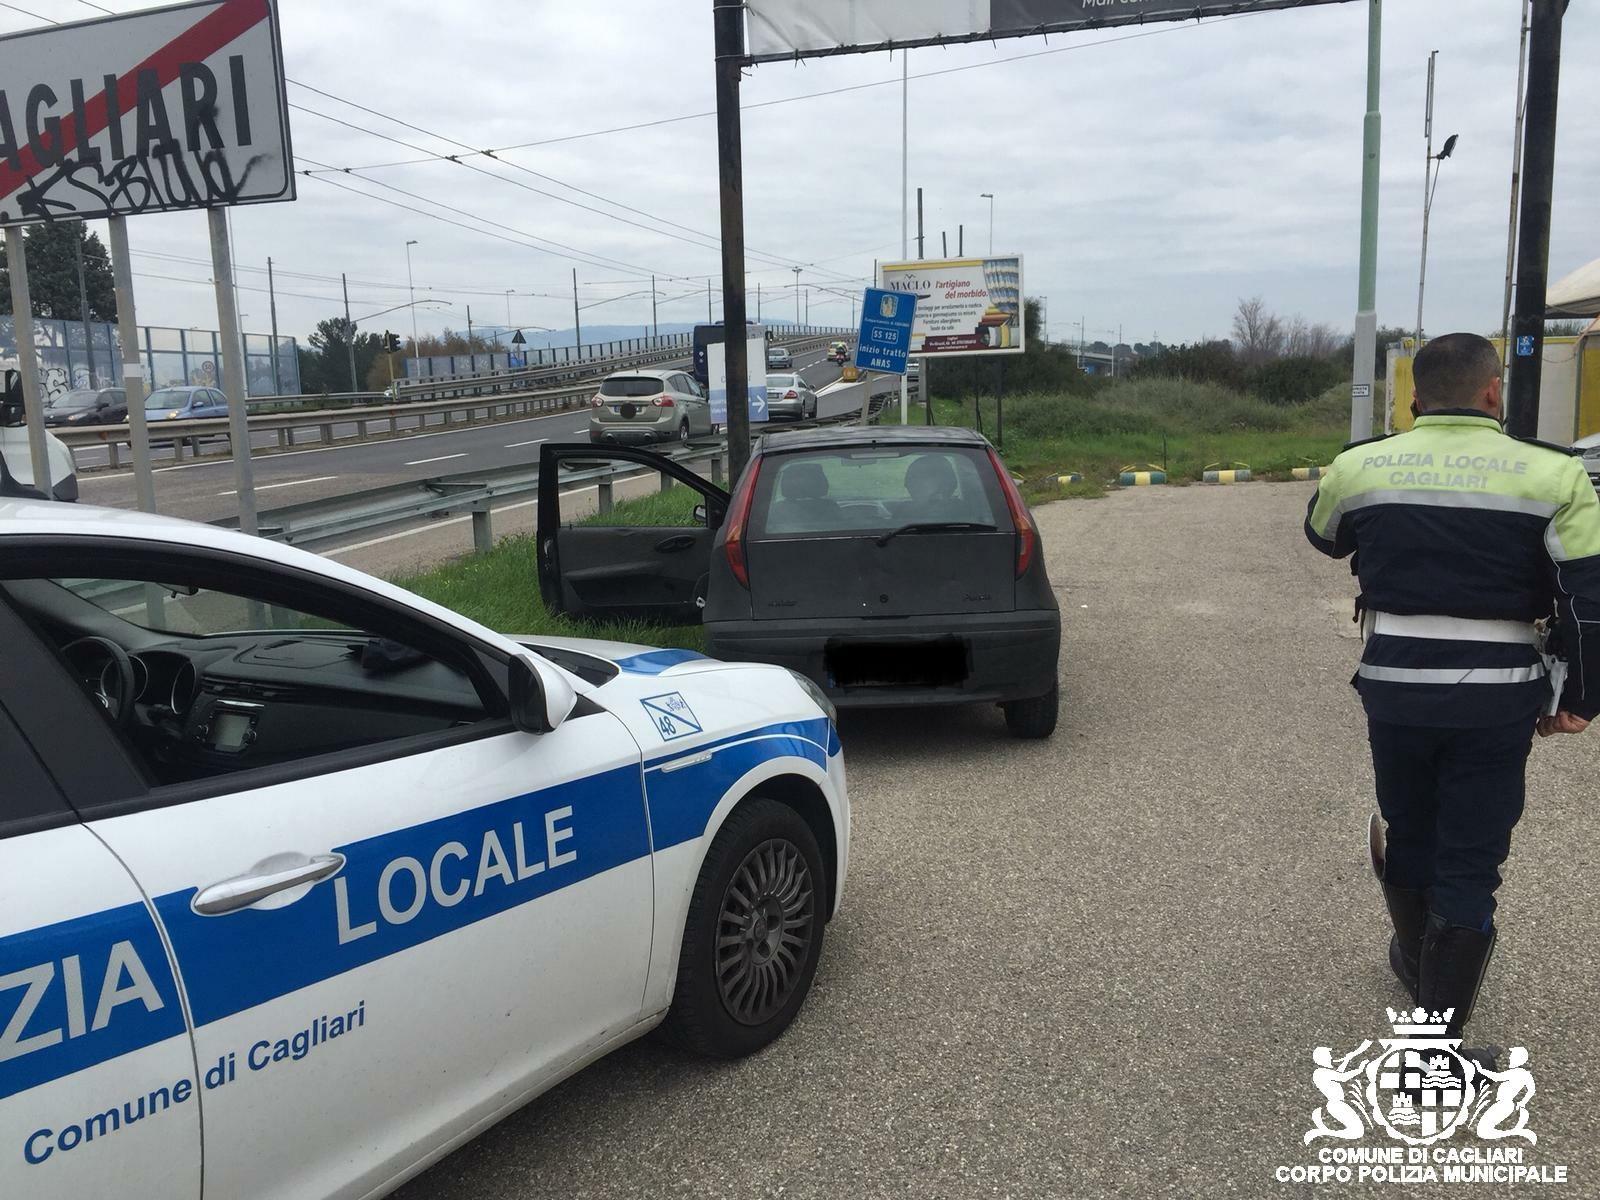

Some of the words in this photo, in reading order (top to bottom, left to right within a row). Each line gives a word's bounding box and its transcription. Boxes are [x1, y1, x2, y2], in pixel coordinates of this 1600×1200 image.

[935, 280, 971, 290] l'artigiano
[945, 291, 956, 299] del
[874, 330, 883, 338] SS
[885, 331, 897, 340] 125
[859, 344, 880, 354] inizio
[883, 347, 906, 358] tratto
[870, 358, 891, 369] ANAS
[1362, 453, 1434, 470] POLIZIA
[1444, 454, 1528, 475] LOCALE
[1389, 471, 1488, 489] CAGLIARI
[659, 716, 677, 736] 48
[335, 805, 577, 946] LOCALE
[23, 1078, 193, 1165] Comune
[204, 1052, 236, 1090] di
[247, 1001, 365, 1071] Cagliari
